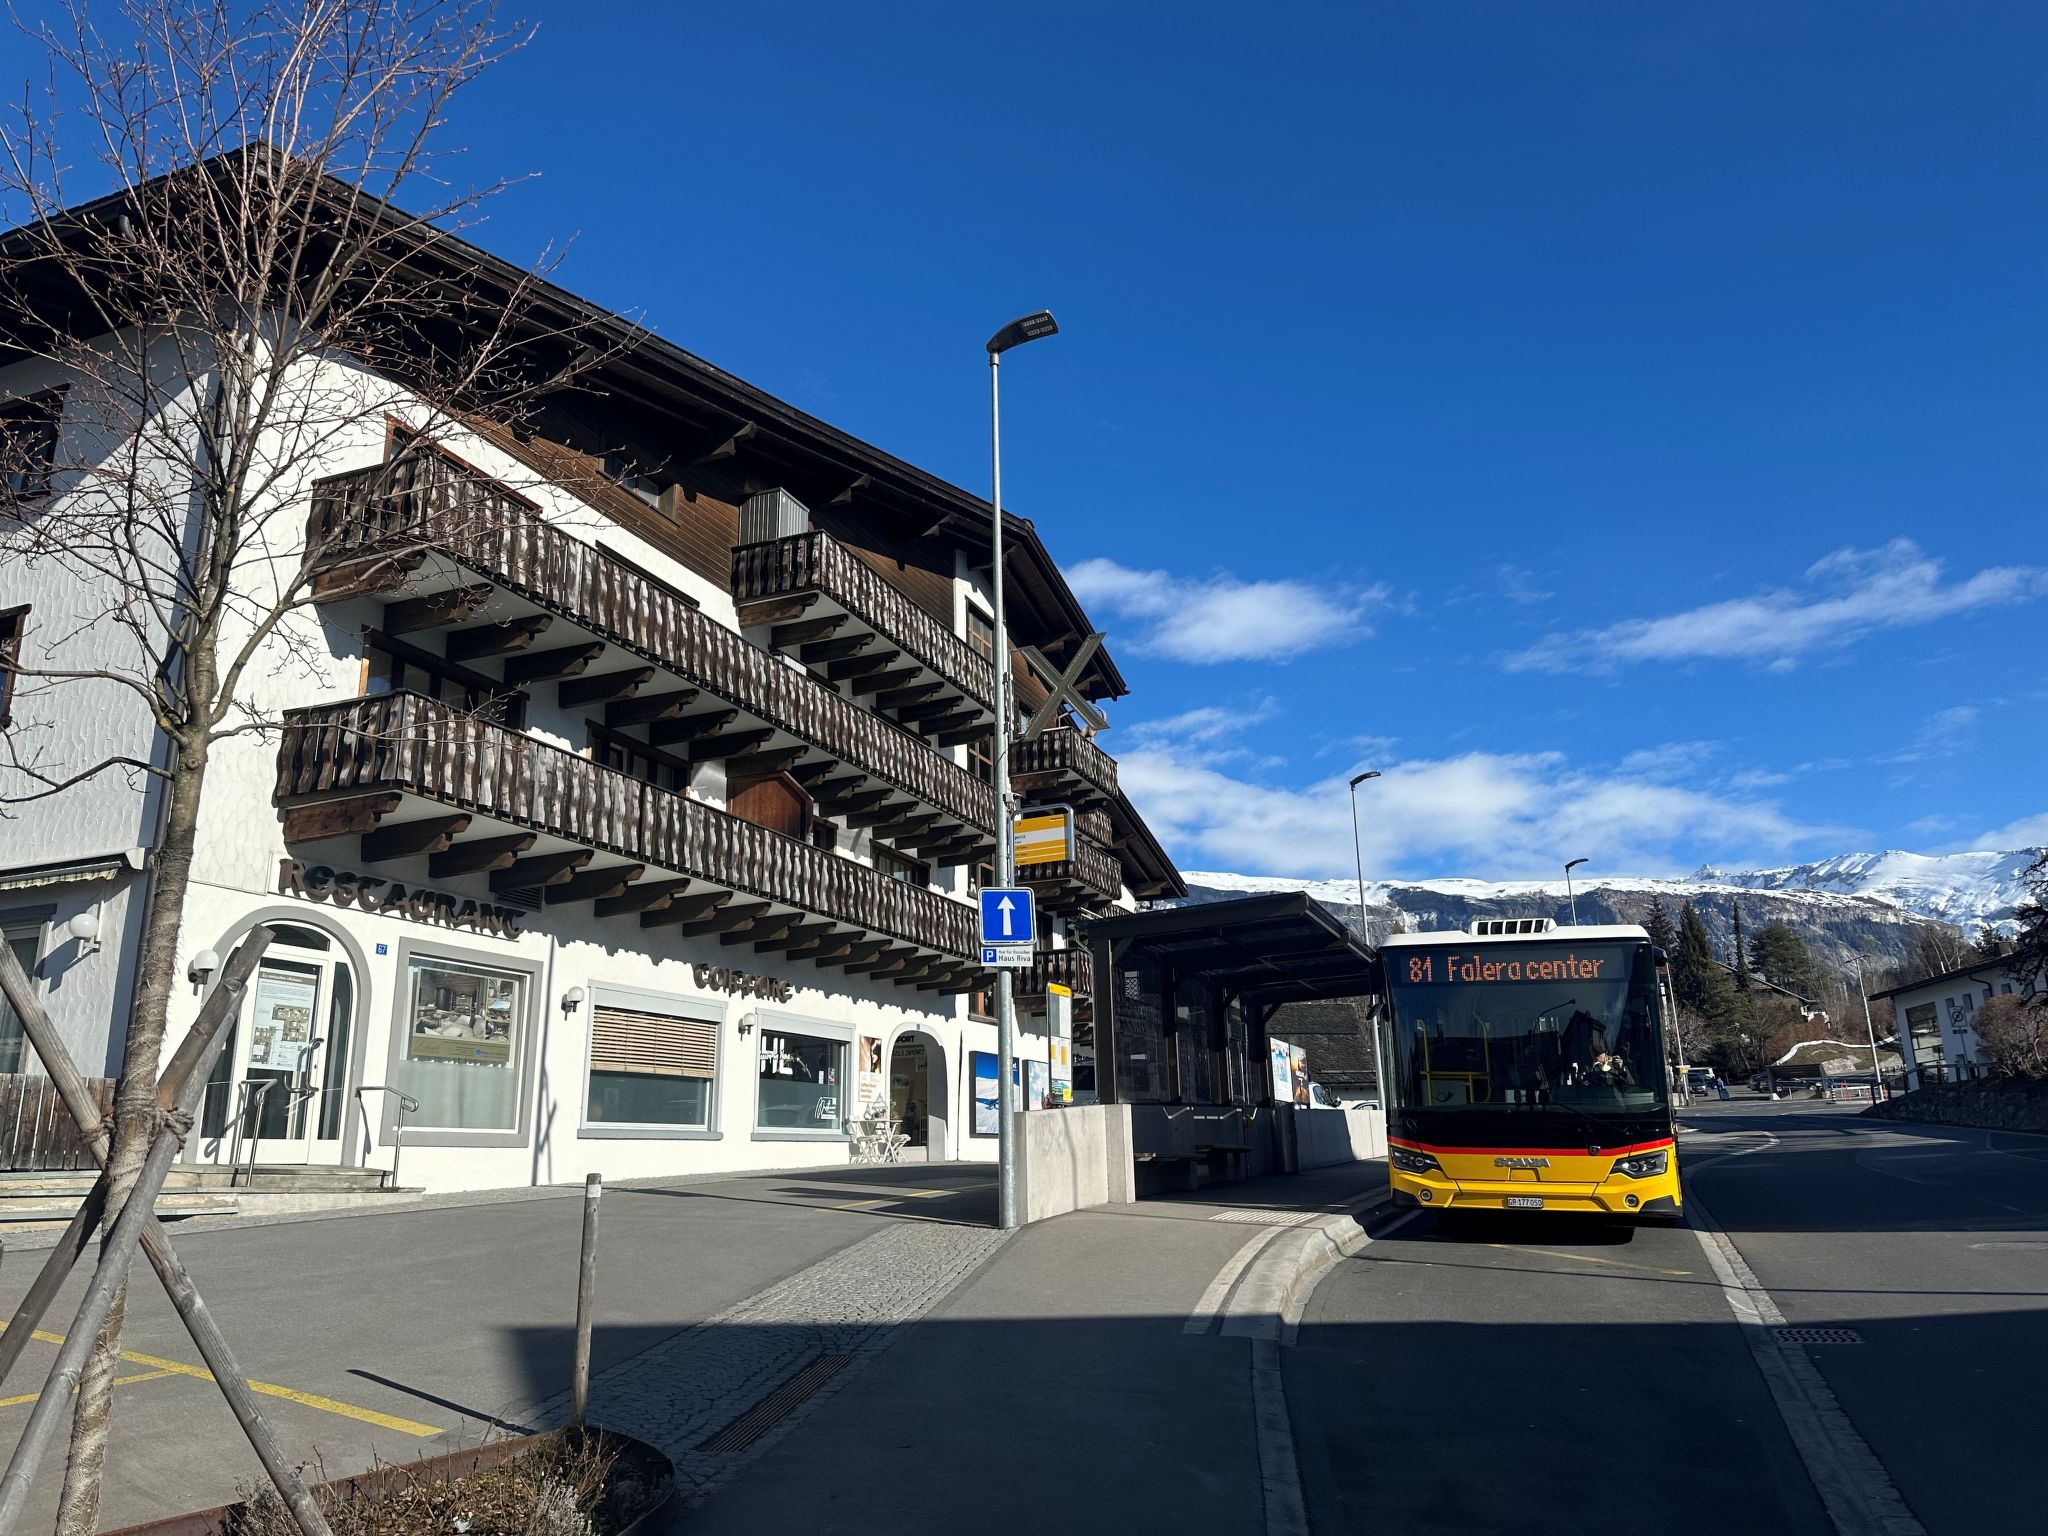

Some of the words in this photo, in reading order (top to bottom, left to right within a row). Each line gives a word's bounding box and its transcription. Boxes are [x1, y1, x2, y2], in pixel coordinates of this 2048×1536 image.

[278, 858, 527, 940] RESTAURANT
[1409, 956, 1433, 983] 81
[1447, 955, 1521, 982] Falera
[1525, 953, 1605, 980] center
[1494, 1157, 1551, 1168] SCANIA
